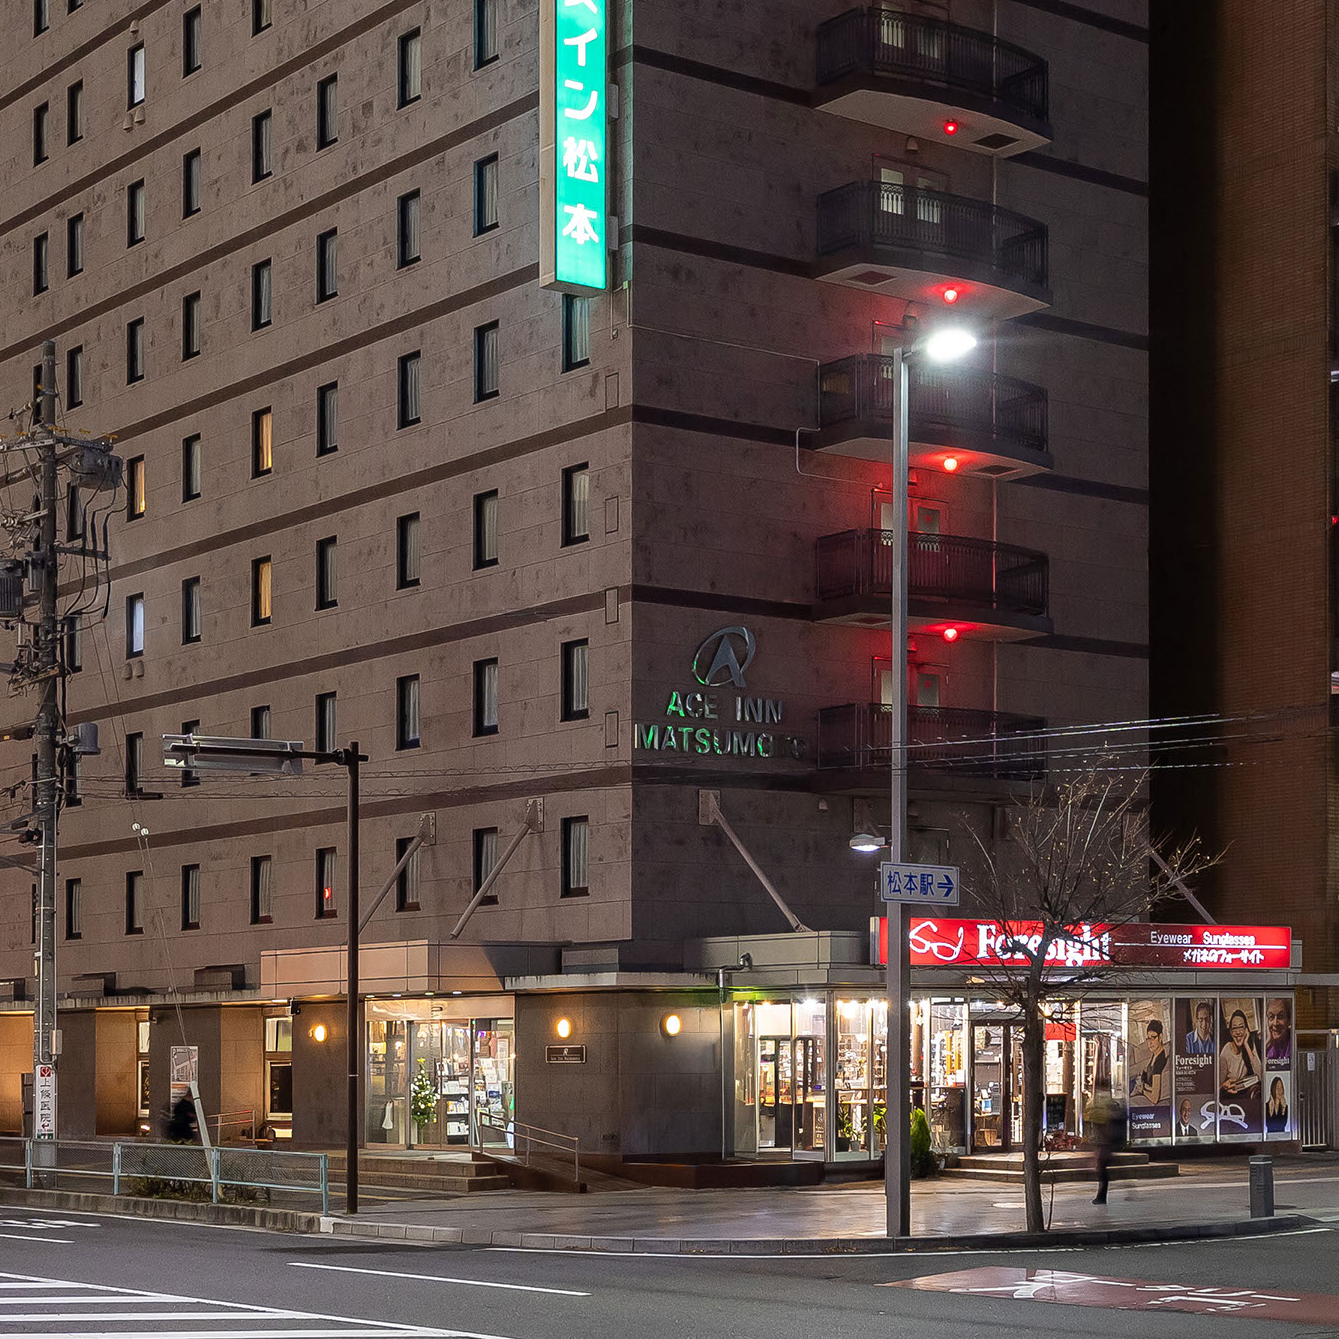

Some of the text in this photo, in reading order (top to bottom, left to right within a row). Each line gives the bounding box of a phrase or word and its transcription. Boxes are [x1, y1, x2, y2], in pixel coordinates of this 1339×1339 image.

[666, 691, 782, 723] ACE INN
[634, 723, 806, 759] MATSUMOO
[887, 872, 935, 896] 松本駅
[976, 924, 1111, 967] Foresight
[1150, 931, 1256, 947] Eyewear Sunglasses
[1175, 1054, 1213, 1068] Foresight
[1131, 1121, 1162, 1130] Sunglasses
